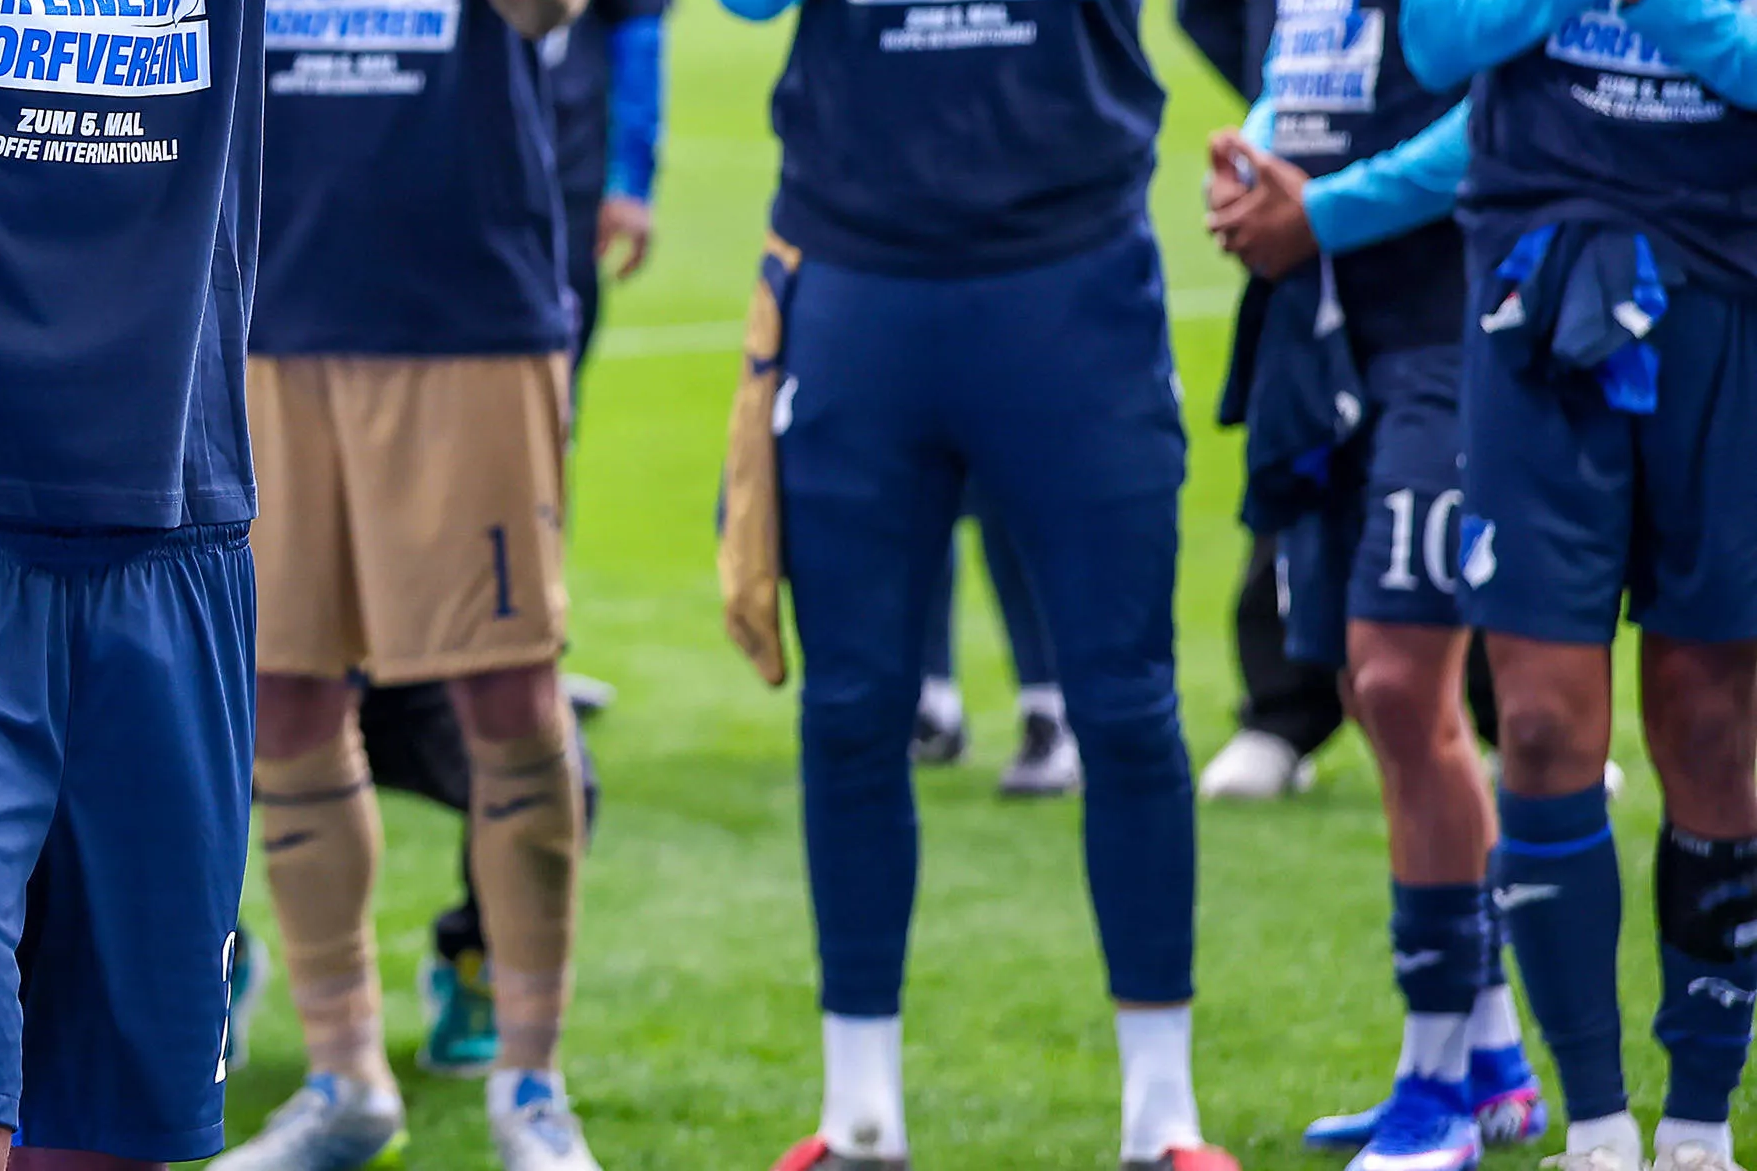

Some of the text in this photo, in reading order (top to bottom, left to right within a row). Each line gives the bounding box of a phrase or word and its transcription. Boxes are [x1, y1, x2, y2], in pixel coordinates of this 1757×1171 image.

[16, 108, 146, 137] ZUM 5. MAL
[42, 138, 179, 165] INTERNATIONAL!
[485, 524, 520, 619] 1
